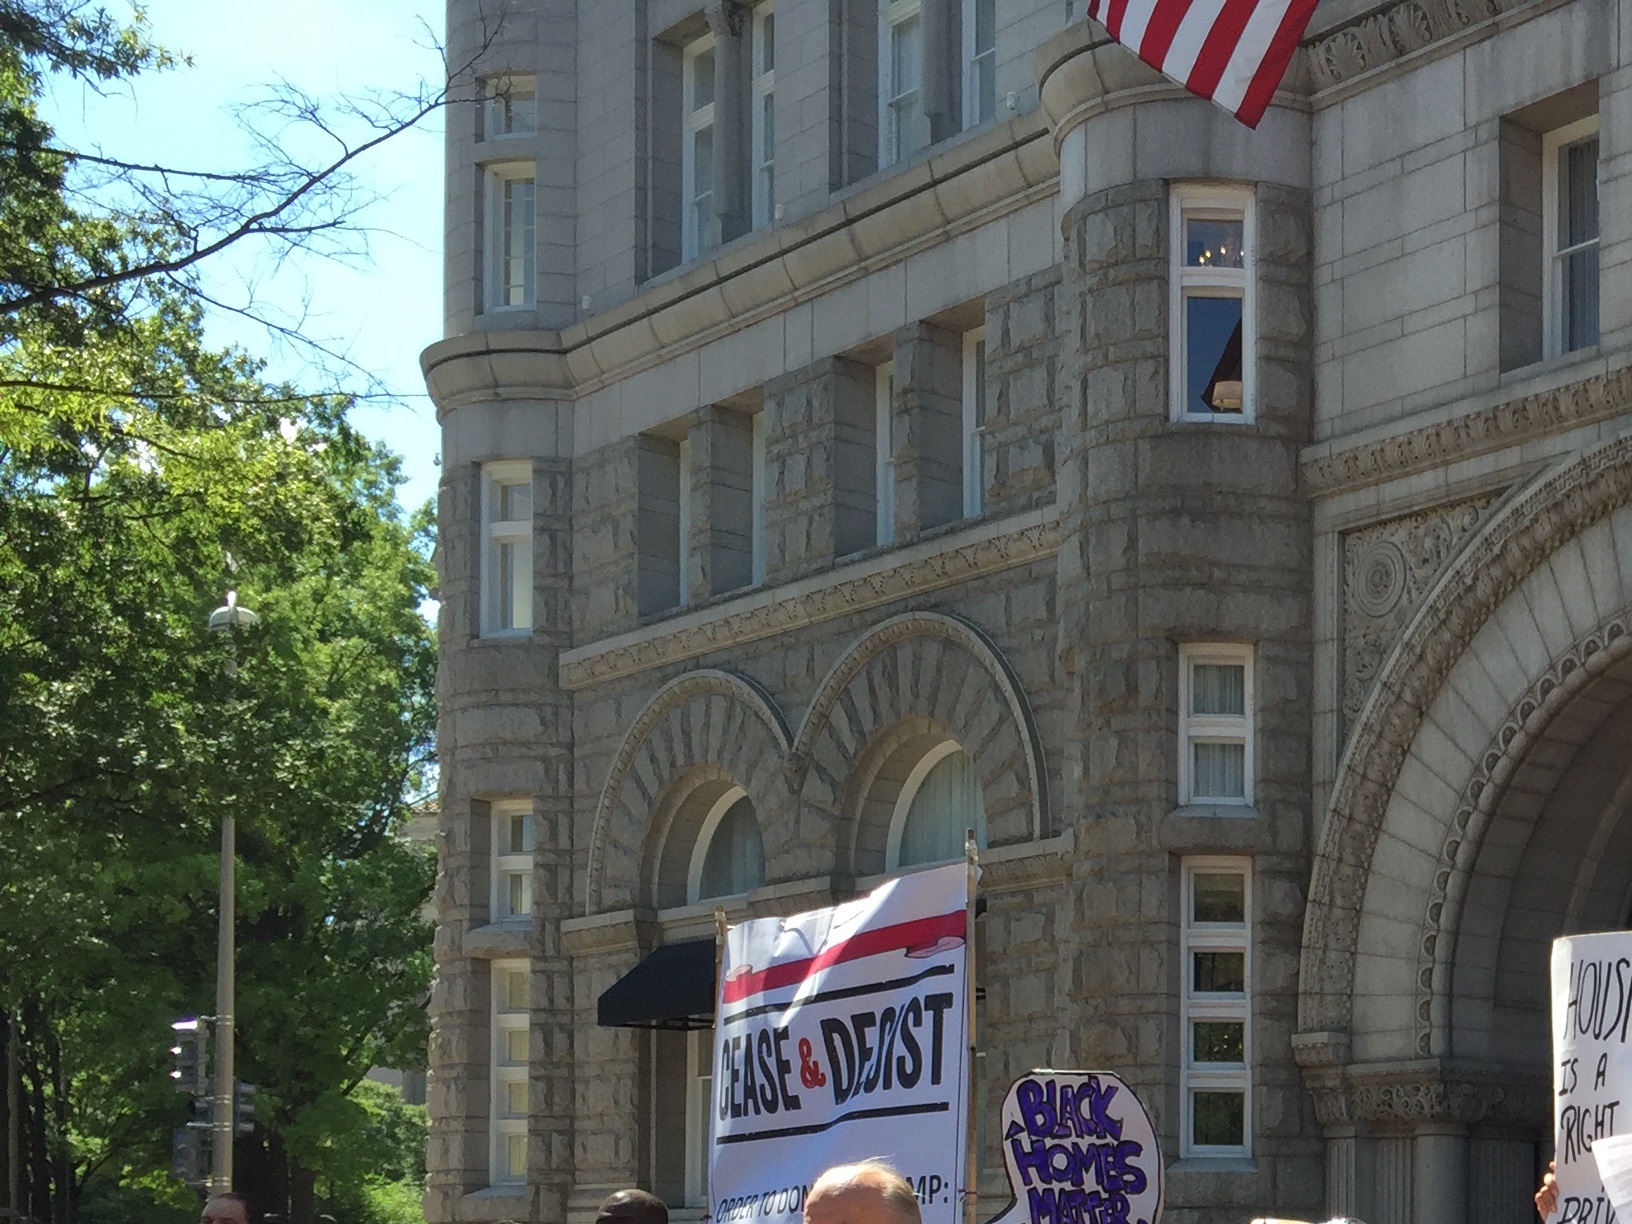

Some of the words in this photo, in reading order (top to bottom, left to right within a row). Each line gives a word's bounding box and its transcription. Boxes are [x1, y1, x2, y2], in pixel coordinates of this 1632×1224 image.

[719, 1026, 802, 1121] CEASE
[798, 1037, 826, 1089] &
[1559, 1058, 1579, 1095] IS
[1594, 1053, 1608, 1091] A
[1016, 1074, 1124, 1141] BLACK
[1560, 1100, 1620, 1165] RIGHT
[1011, 1138, 1147, 1195] HOMES
[716, 1192, 758, 1224] ORDER
[758, 1189, 775, 1217] TO
[777, 1184, 814, 1215] DON
